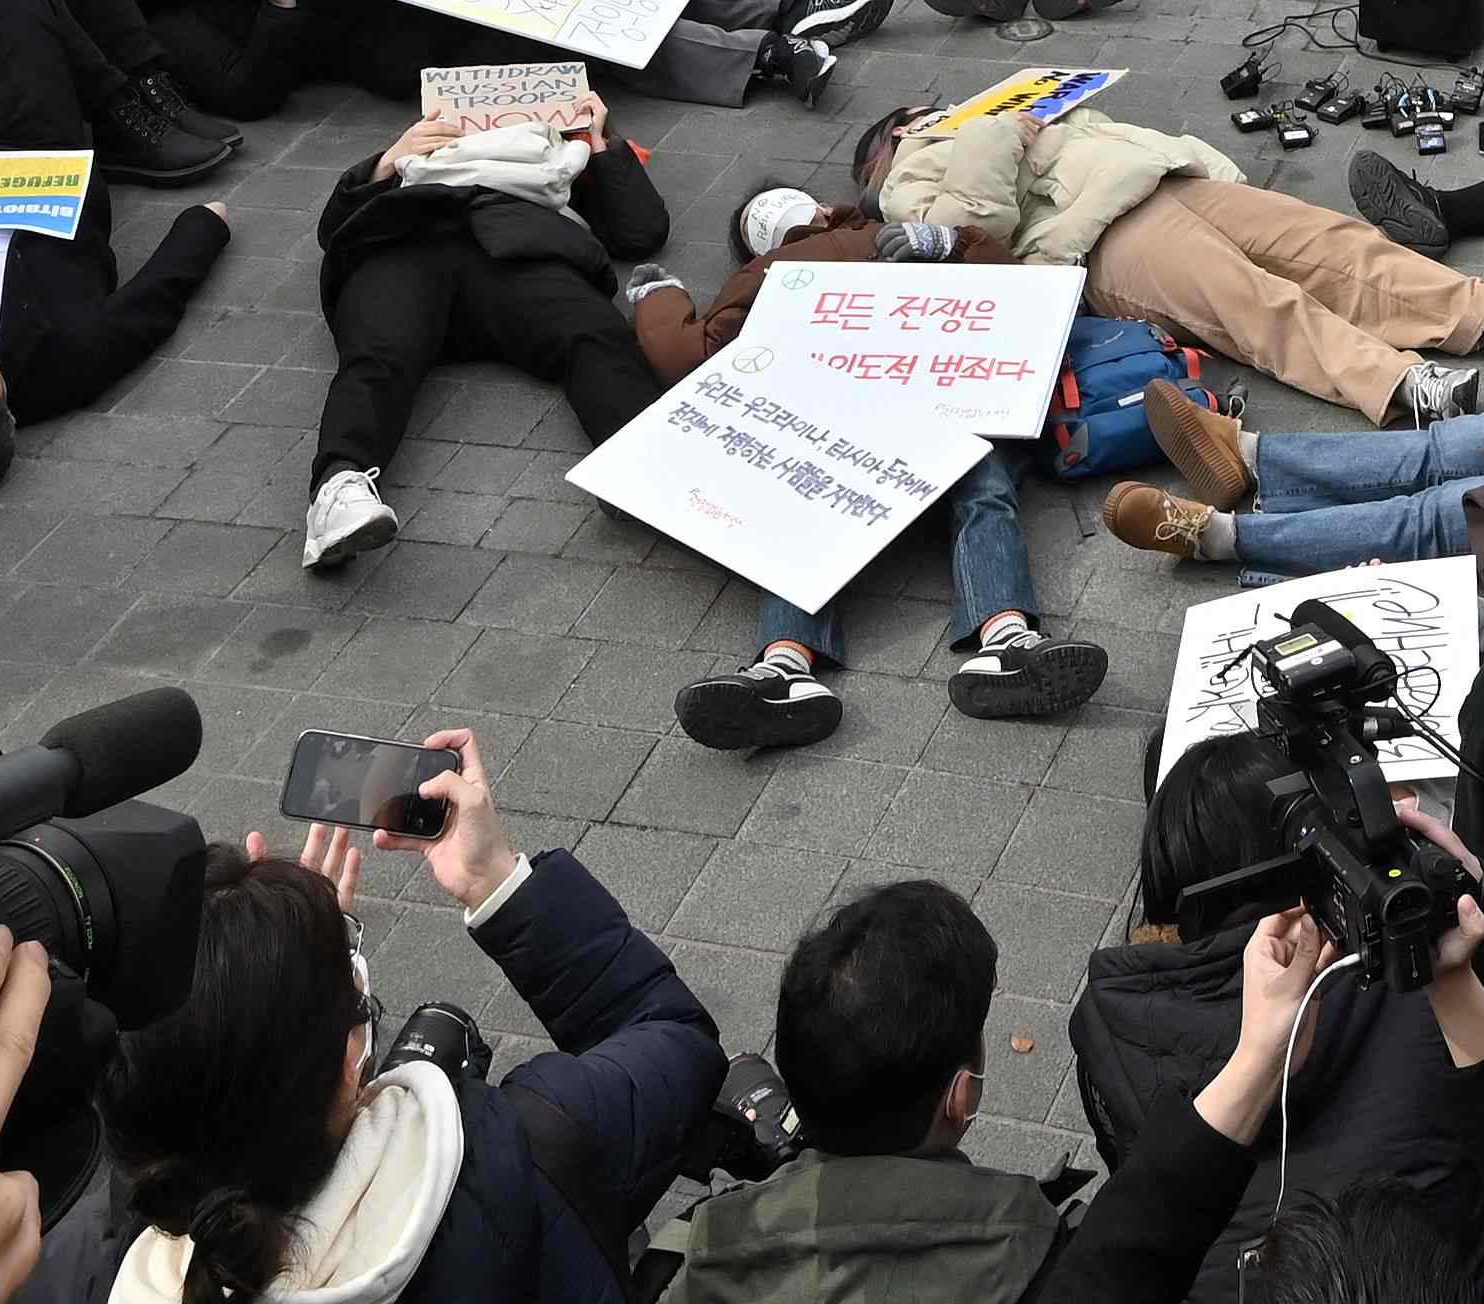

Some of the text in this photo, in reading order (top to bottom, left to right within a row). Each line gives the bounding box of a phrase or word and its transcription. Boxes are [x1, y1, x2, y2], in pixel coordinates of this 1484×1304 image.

[425, 64, 586, 84] WITHDRAW
[437, 77, 578, 97] RUSSIAN
[442, 91, 578, 109] TROOPS
[459, 109, 584, 132] NOW
[809, 292, 997, 334] 모든 전쟁은
[928, 355, 1037, 388] 범죄다
[696, 372, 745, 409] 우리는
[740, 395, 831, 453] 우크라이나,
